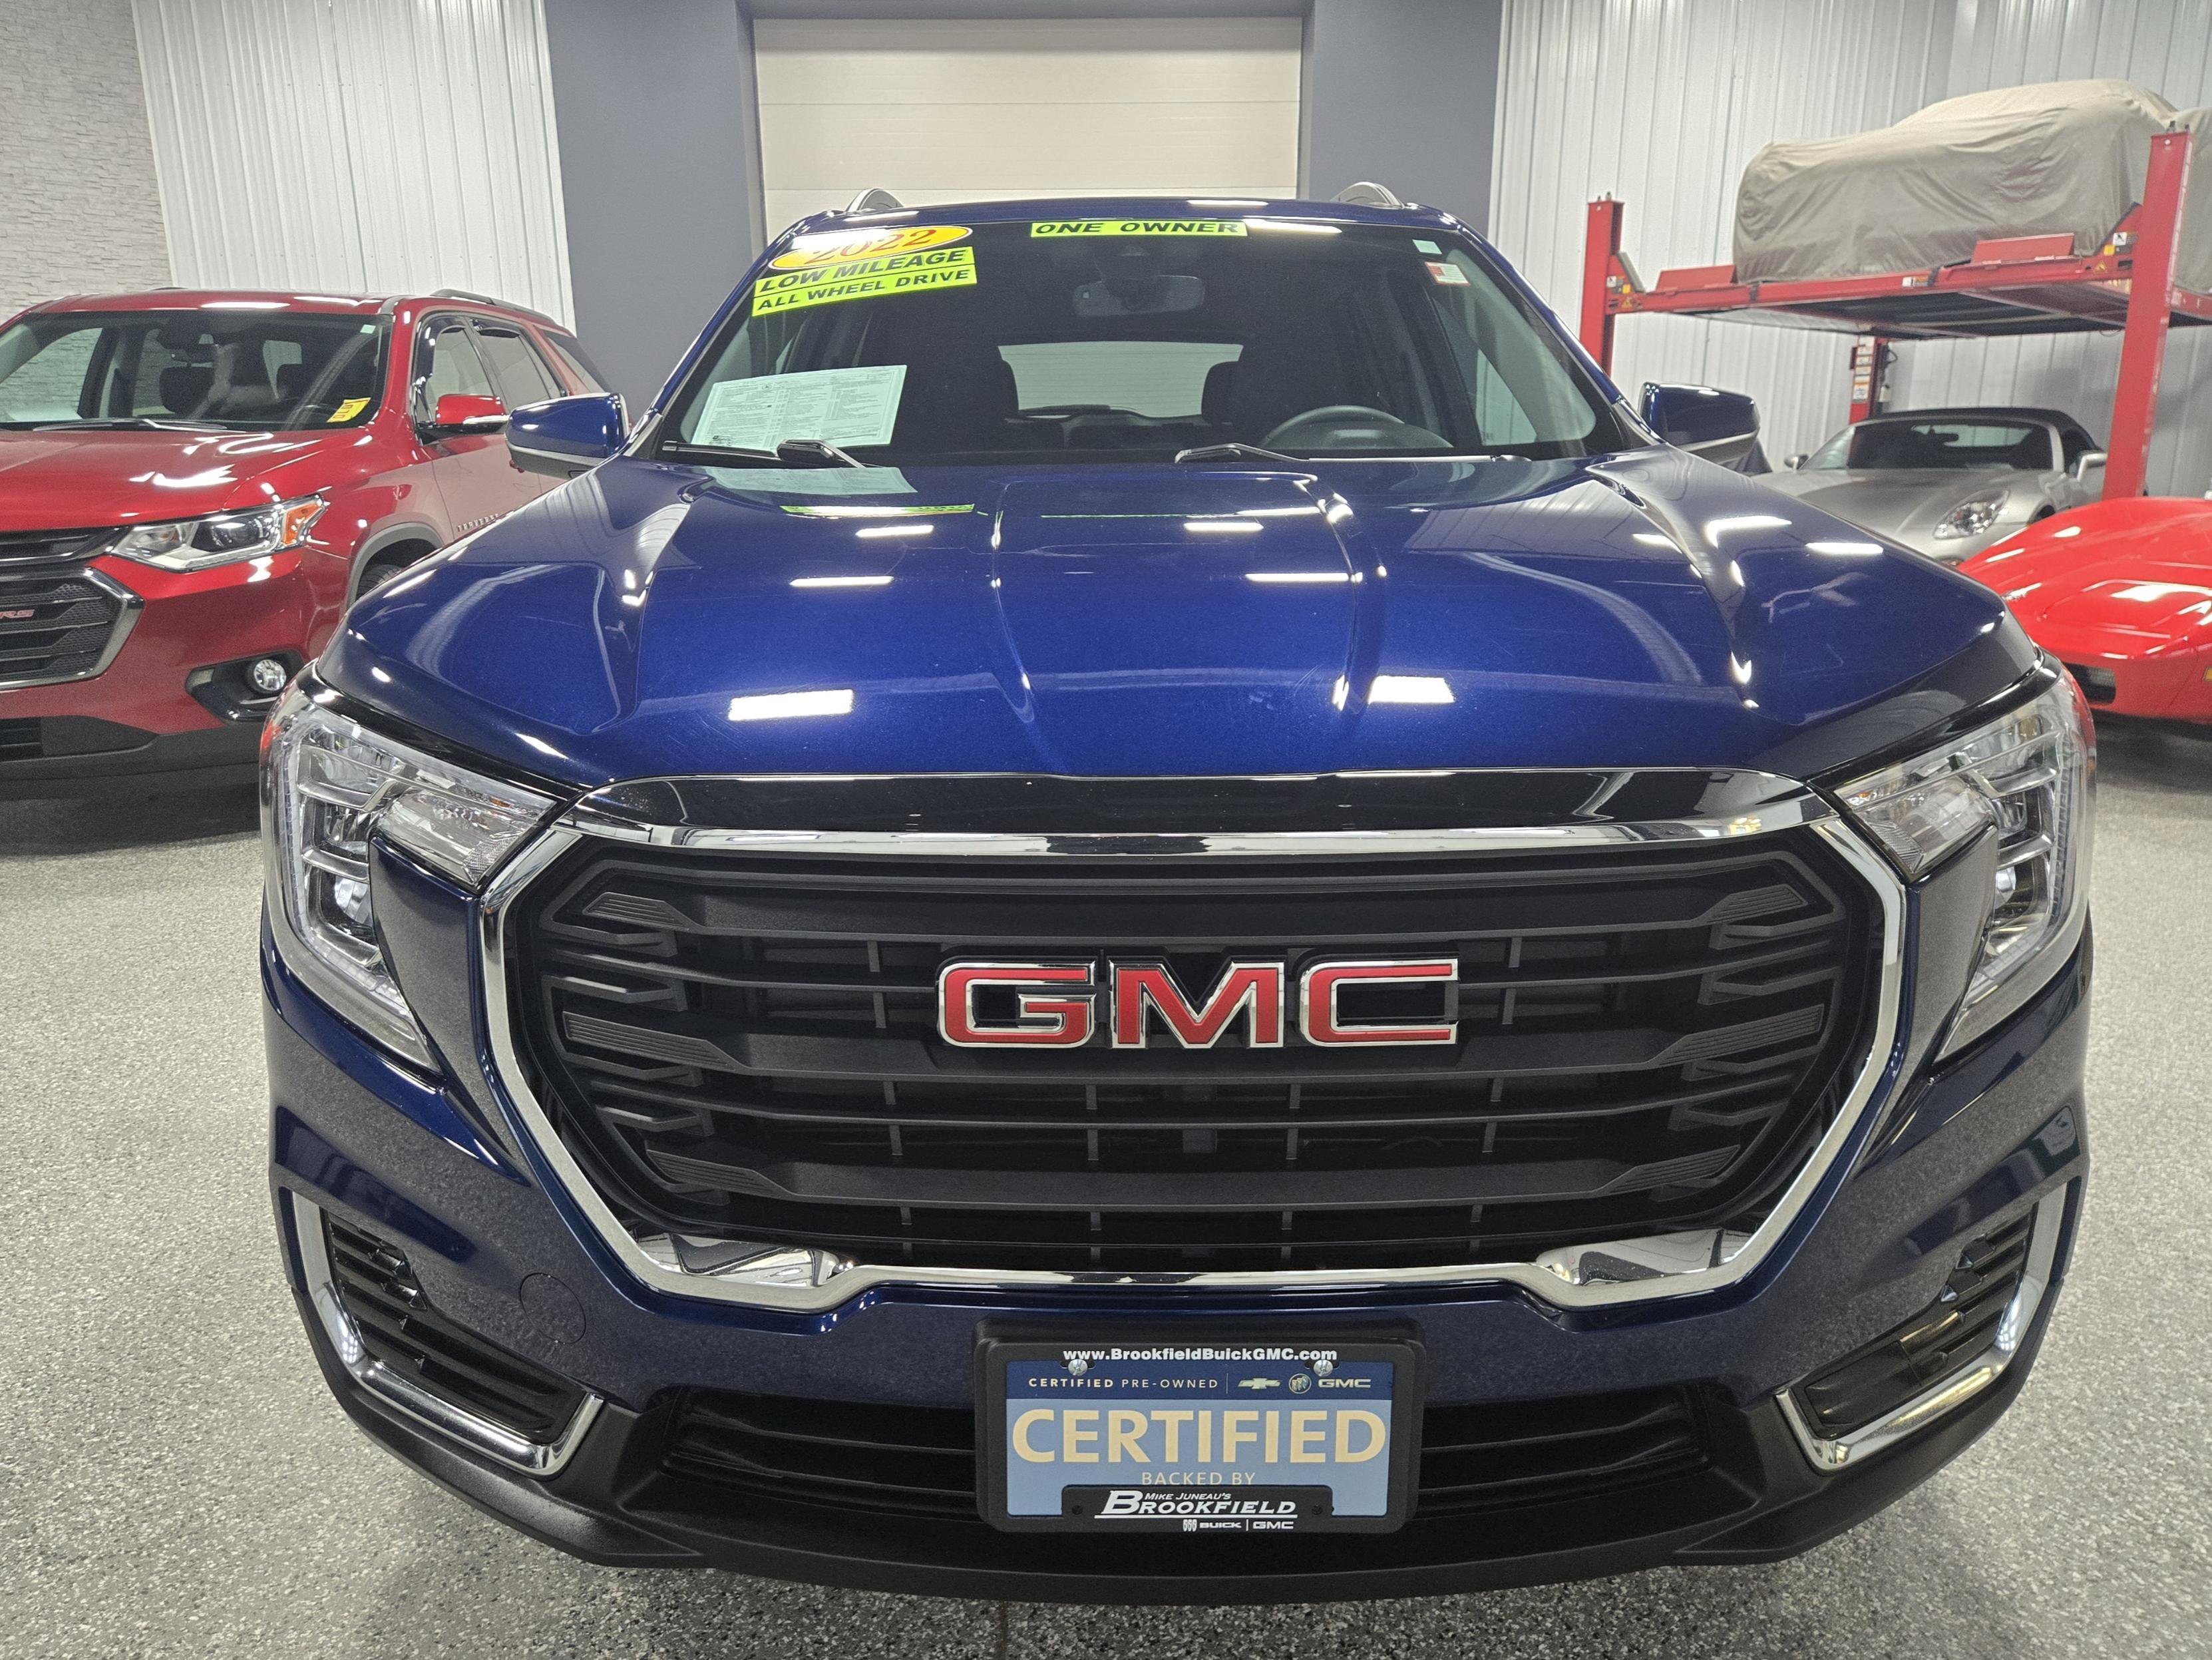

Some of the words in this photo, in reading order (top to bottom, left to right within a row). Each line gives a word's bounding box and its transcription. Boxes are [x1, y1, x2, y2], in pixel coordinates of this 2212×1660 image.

[1035, 222, 1103, 234] ONE
[1120, 222, 1239, 233] OWNER
[759, 269, 829, 293] LOW
[833, 250, 967, 278] MILEAGE
[757, 294, 801, 310] ALL
[807, 281, 886, 300] WHEEL
[895, 270, 971, 288] DRIVE
[938, 957, 1459, 1049] GMC
[1063, 1347, 1338, 1360] www.BrookfieldBuickGMC.com
[1028, 1377, 1114, 1388] CERTIFIED
[1122, 1378, 1218, 1388] PRE-OWNED
[1318, 1378, 1372, 1389] GMC
[1012, 1408, 1387, 1463] CERTIFIED
[1141, 1472, 1223, 1486] BACKED
[1231, 1472, 1256, 1486] BY
[1100, 1490, 1296, 1514] BROOKFIELD
[1252, 1521, 1294, 1530] GMC
